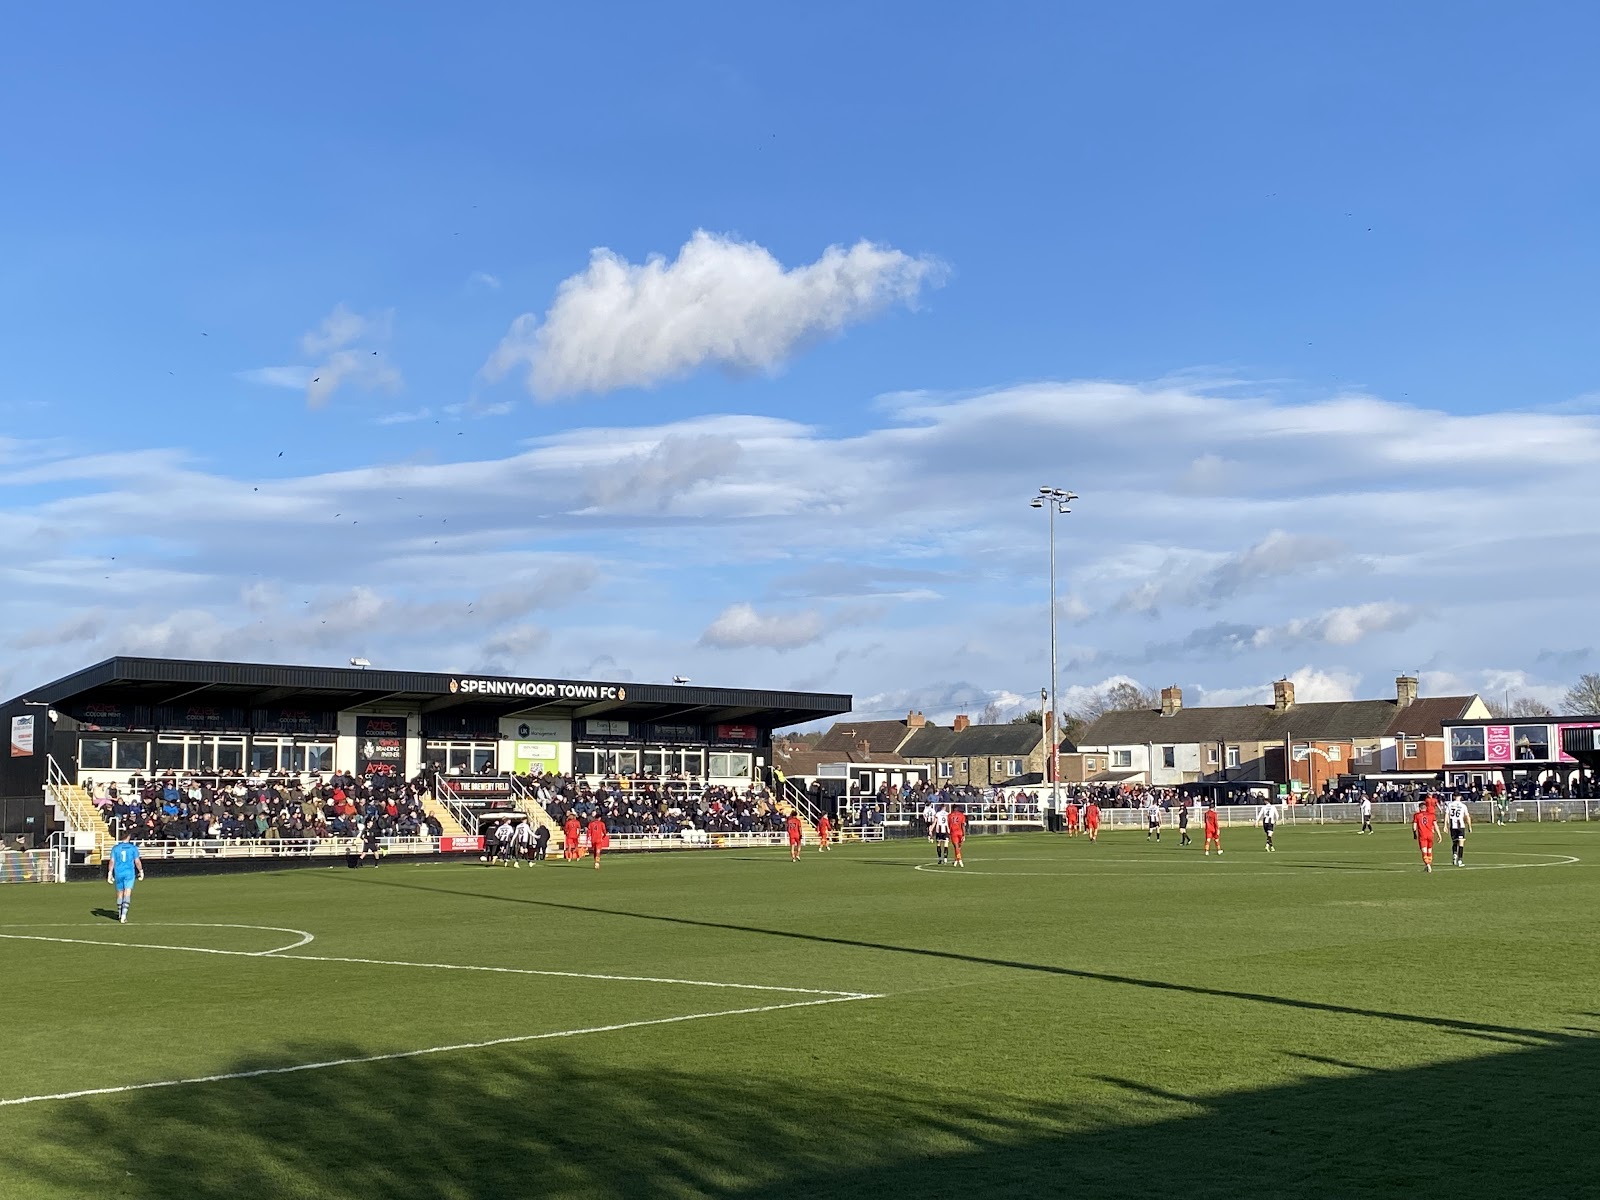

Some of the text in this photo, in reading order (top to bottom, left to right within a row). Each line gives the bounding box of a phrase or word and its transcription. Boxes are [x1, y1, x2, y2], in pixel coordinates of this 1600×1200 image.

[460, 679, 616, 699] SPENNYMOOR TOWN FC
[367, 719, 397, 730] Aztec
[365, 761, 397, 774] Aztec
[460, 782, 471, 791] THE
[495, 782, 510, 791] FIELD
[1450, 808, 1461, 818] 36
[120, 850, 127, 863] 1
